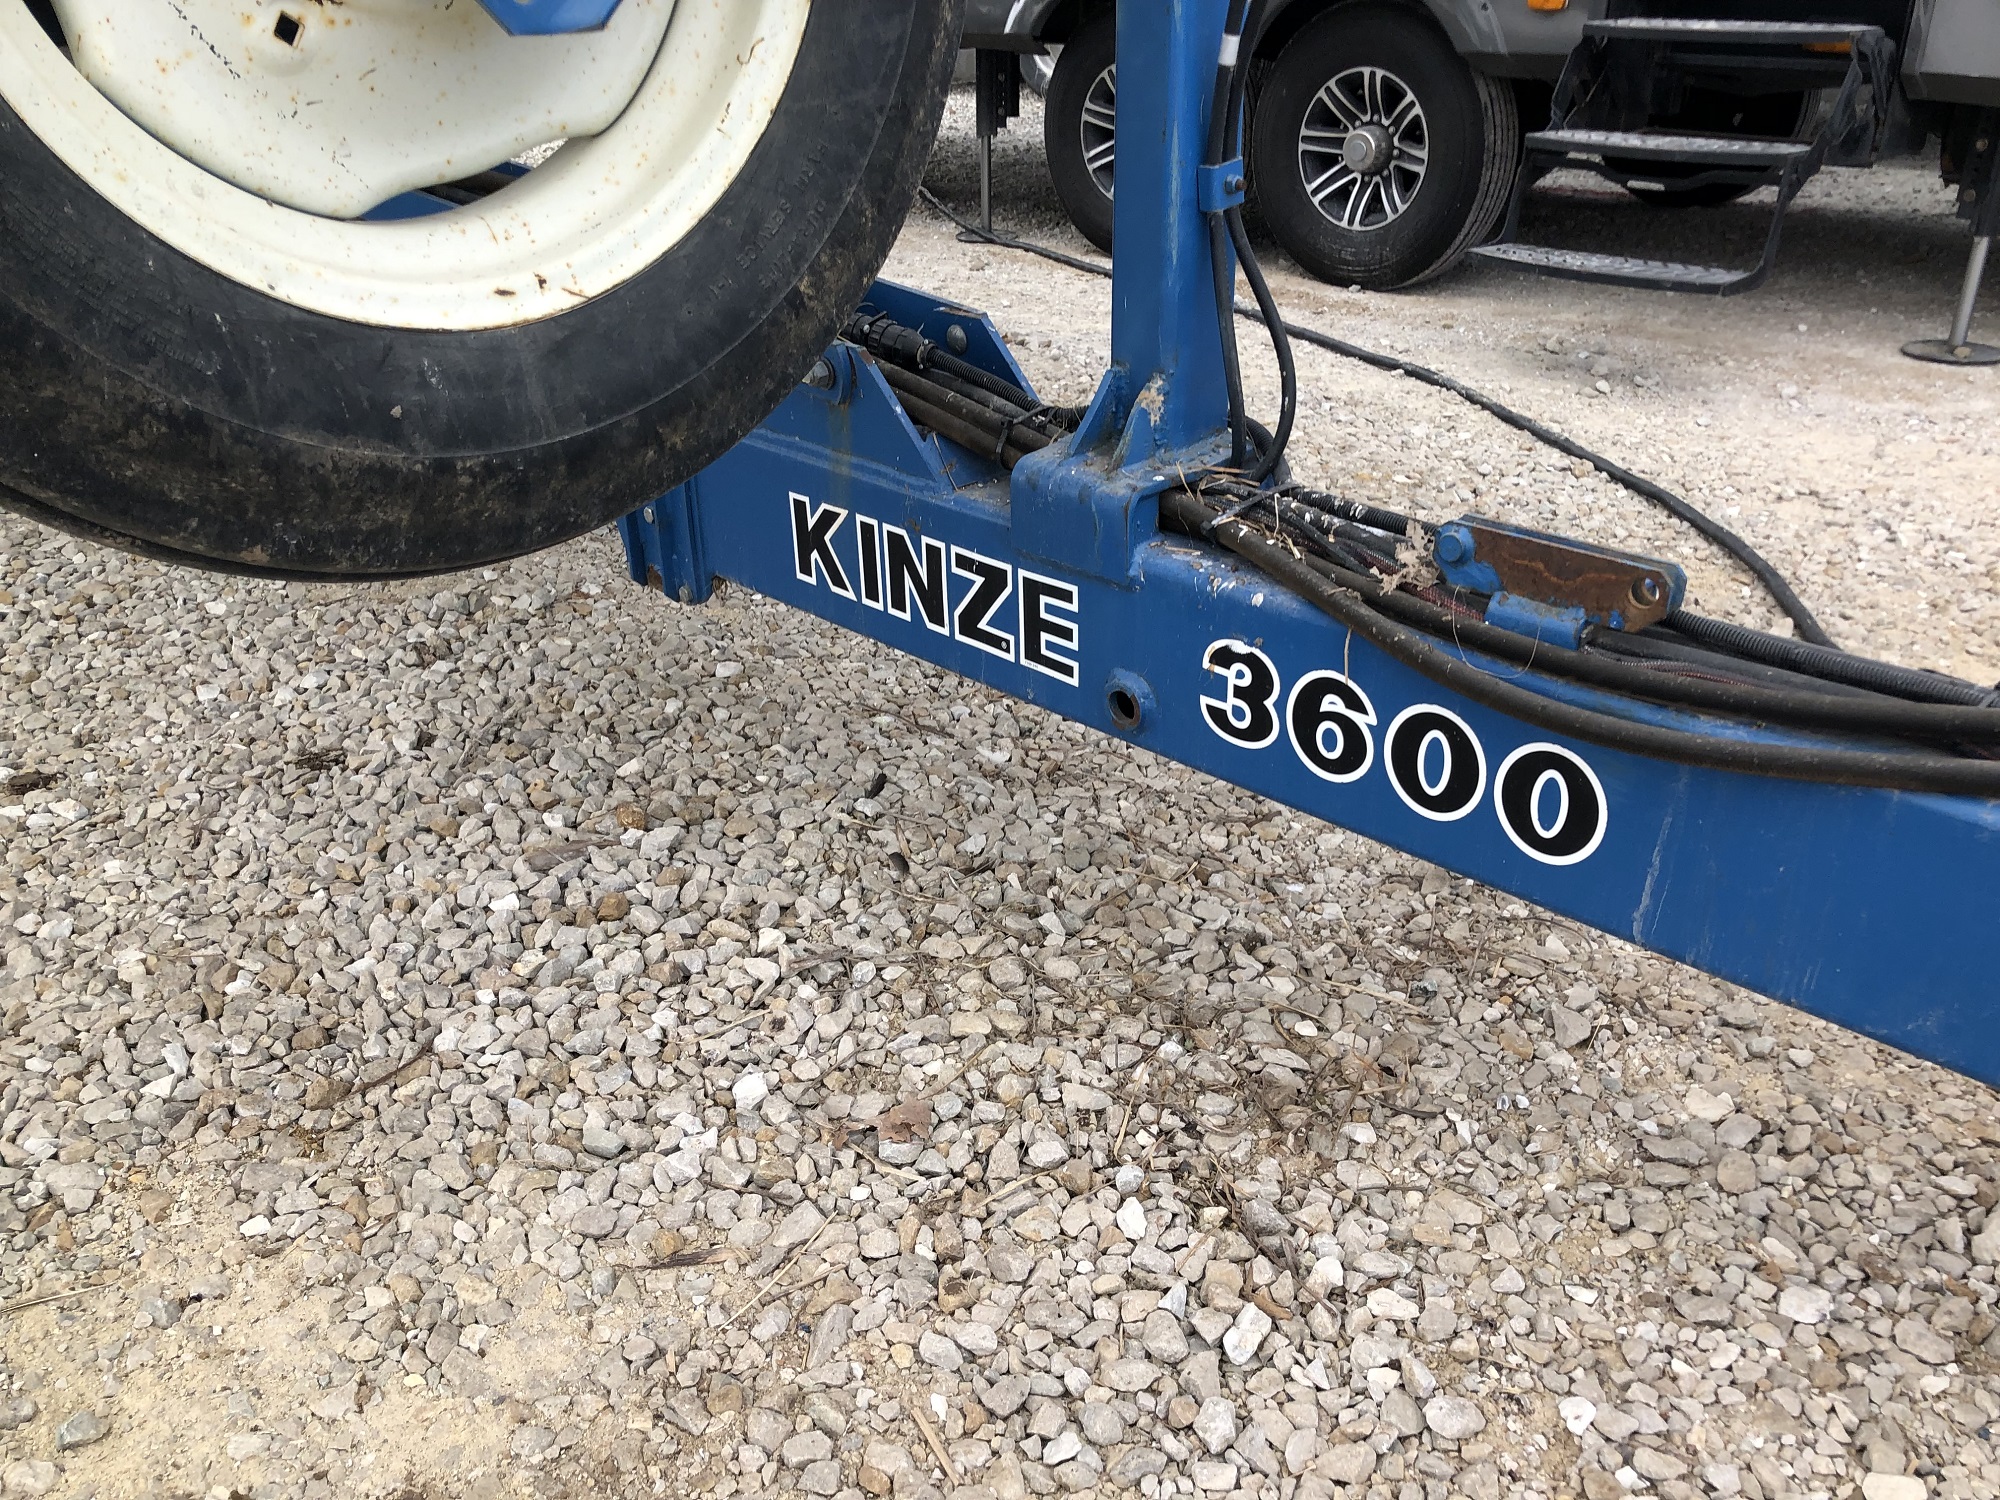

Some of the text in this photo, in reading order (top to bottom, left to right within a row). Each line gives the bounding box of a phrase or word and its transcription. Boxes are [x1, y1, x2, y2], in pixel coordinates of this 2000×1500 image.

[735, 199, 792, 270] SERVICE
[789, 491, 1608, 866] KINZE 3600
